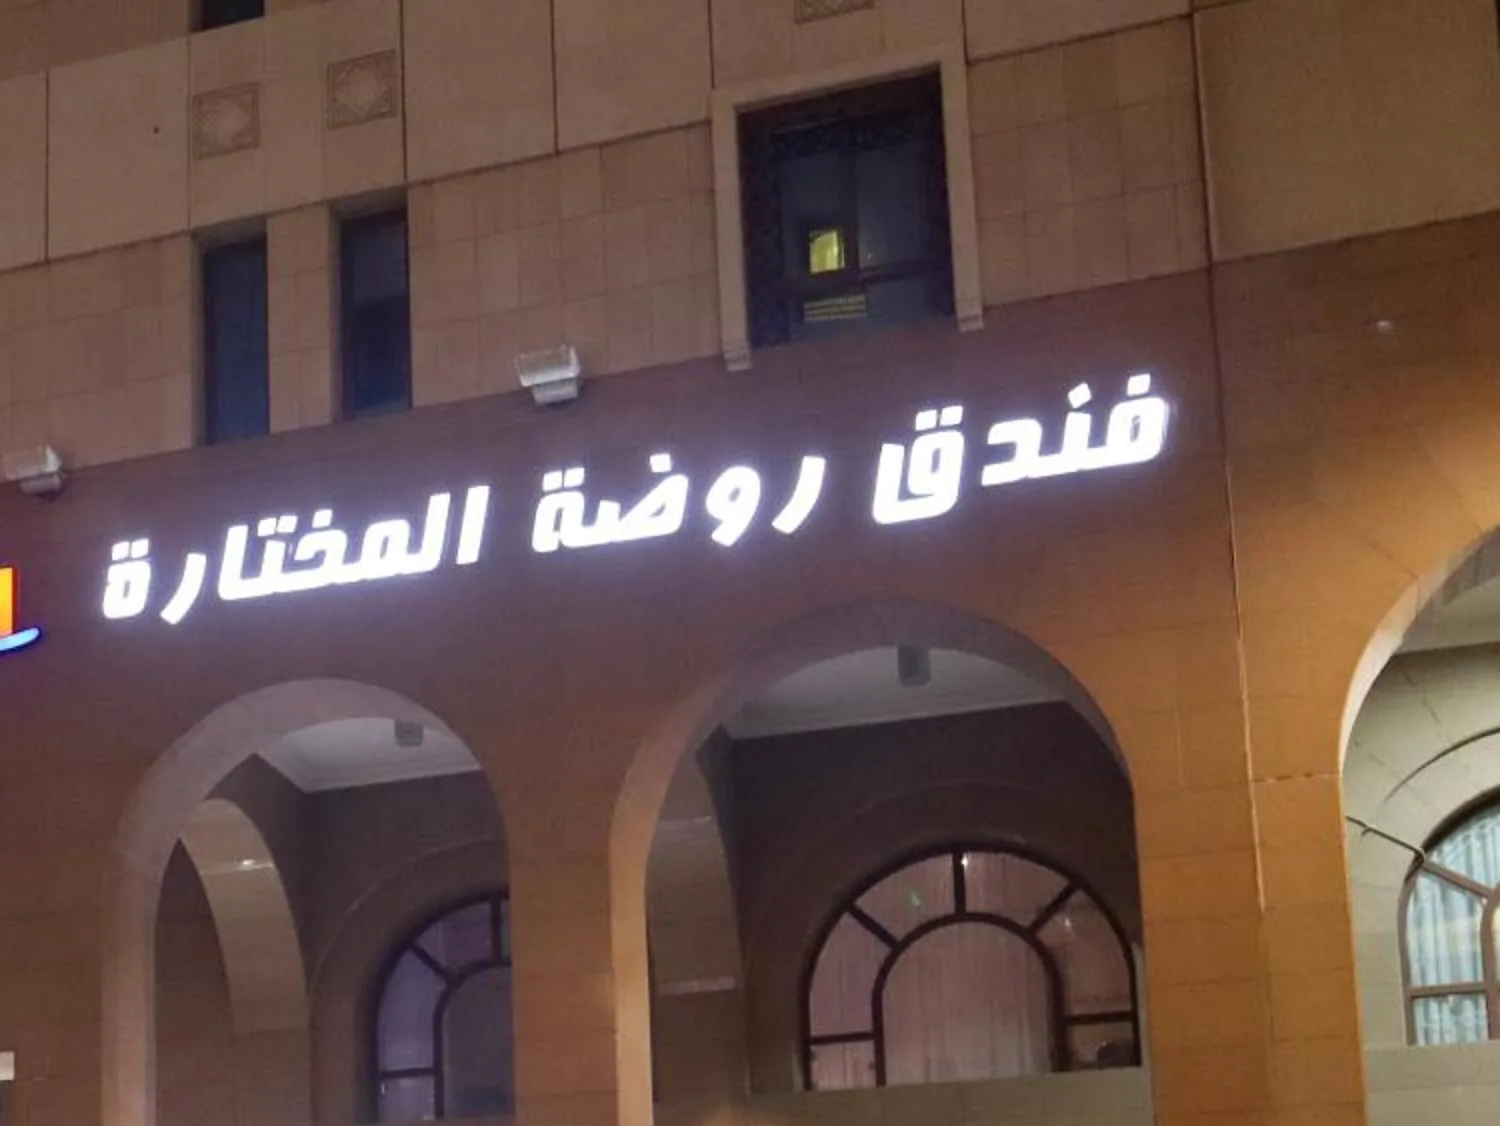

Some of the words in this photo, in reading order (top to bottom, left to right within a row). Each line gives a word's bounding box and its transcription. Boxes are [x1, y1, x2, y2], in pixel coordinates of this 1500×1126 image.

[531, 452, 827, 554] روضة
[871, 373, 1171, 526] فندق
[101, 484, 491, 625] المختارة
